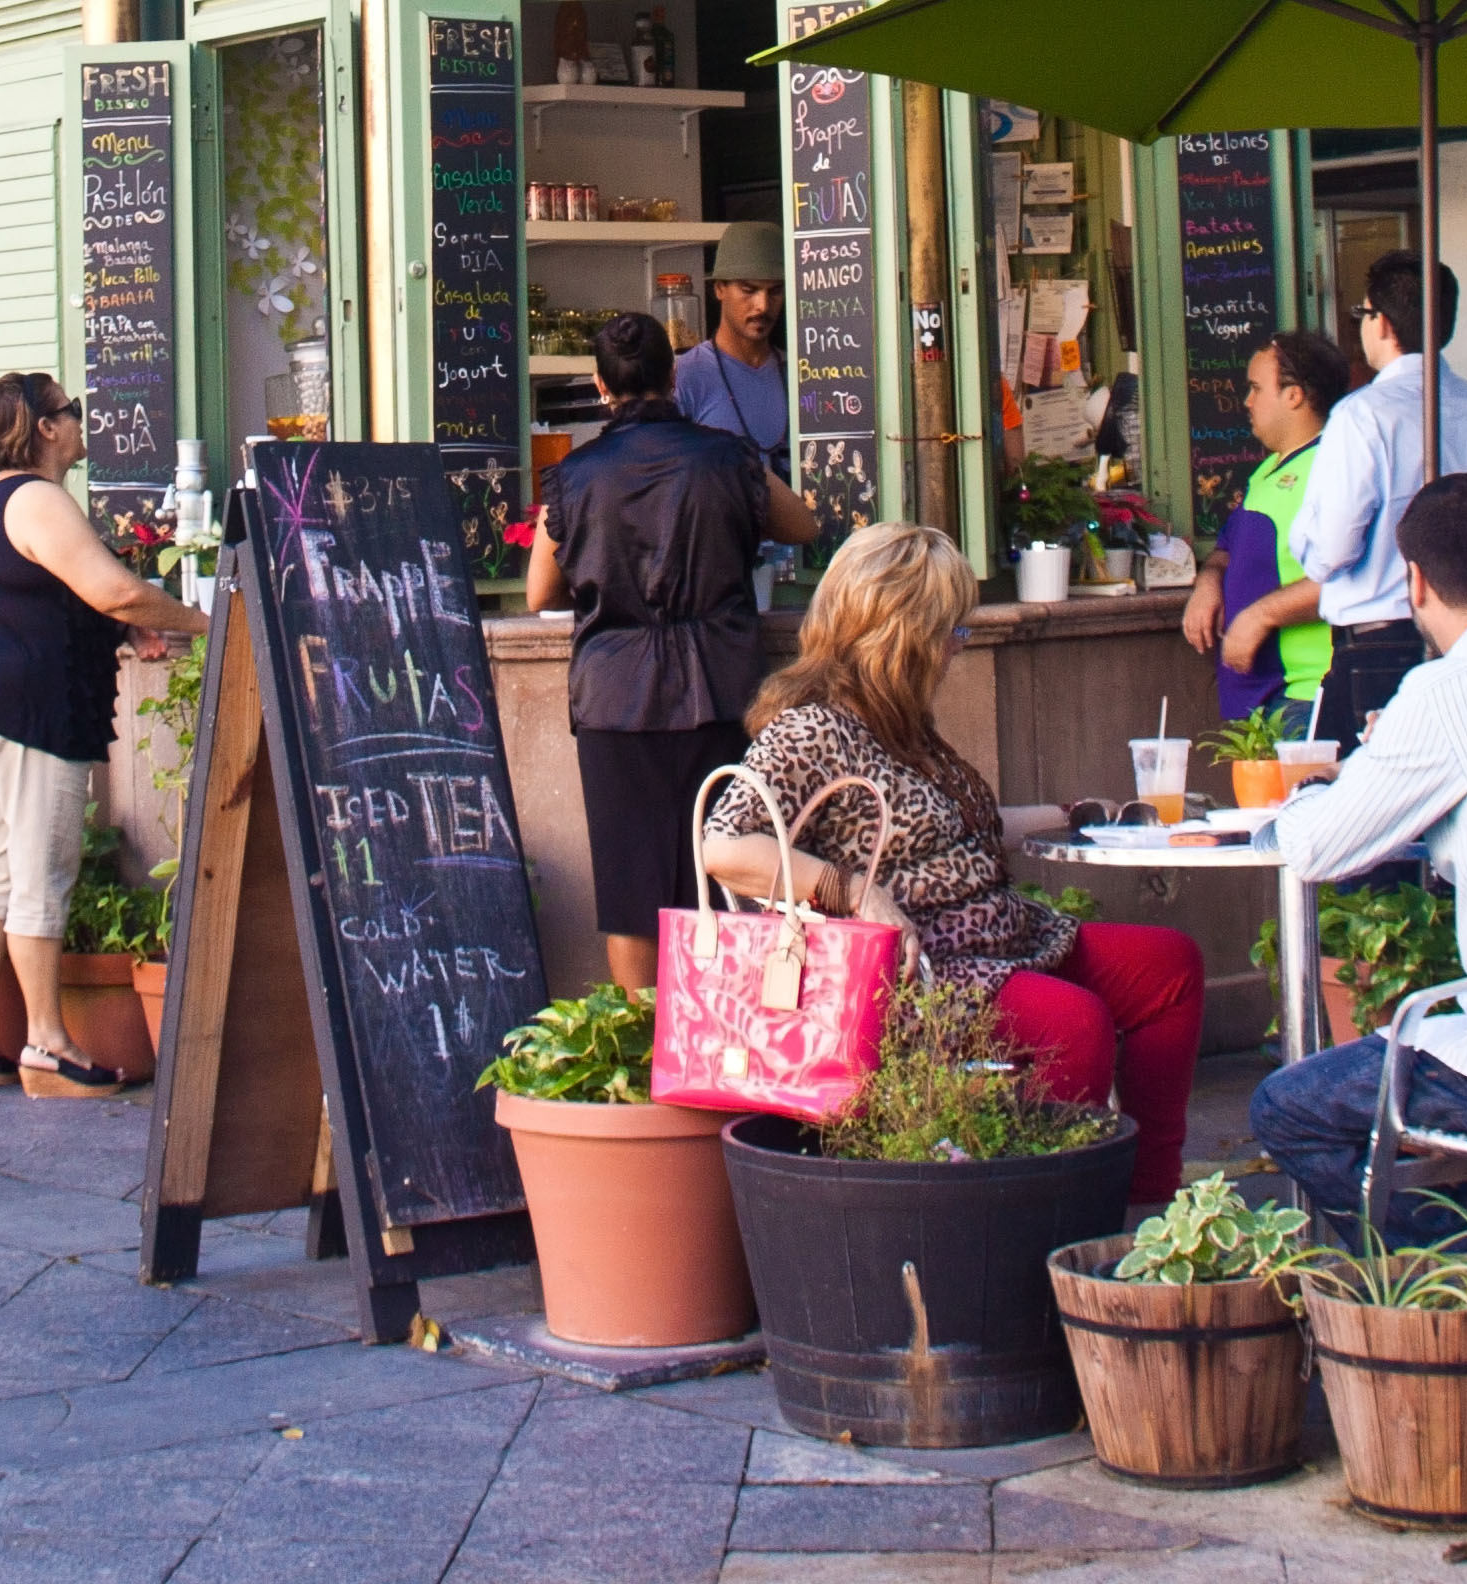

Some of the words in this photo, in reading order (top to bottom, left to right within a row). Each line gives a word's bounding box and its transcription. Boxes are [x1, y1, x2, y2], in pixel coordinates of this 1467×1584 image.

[431, 19, 512, 61] FRESH
[440, 57, 498, 77] BISTRO
[83, 63, 169, 101] FRESH
[95, 97, 150, 112] BISTRO
[92, 132, 155, 155] Menu
[434, 151, 514, 191] Ensalada
[812, 152, 831, 172] de
[1213, 154, 1230, 167] DE
[794, 171, 867, 228] FRUTAS
[115, 214, 134, 228] DE
[803, 263, 862, 291] MANGO
[435, 279, 512, 305] Ensalada
[1186, 291, 1269, 318] Lasañita
[800, 297, 865, 320] PAPAYA
[805, 326, 861, 355] Piña
[799, 358, 868, 383] Banana
[315, 784, 409, 829] ICED
[407, 771, 517, 857] TEA
[364, 946, 526, 994] WATER
